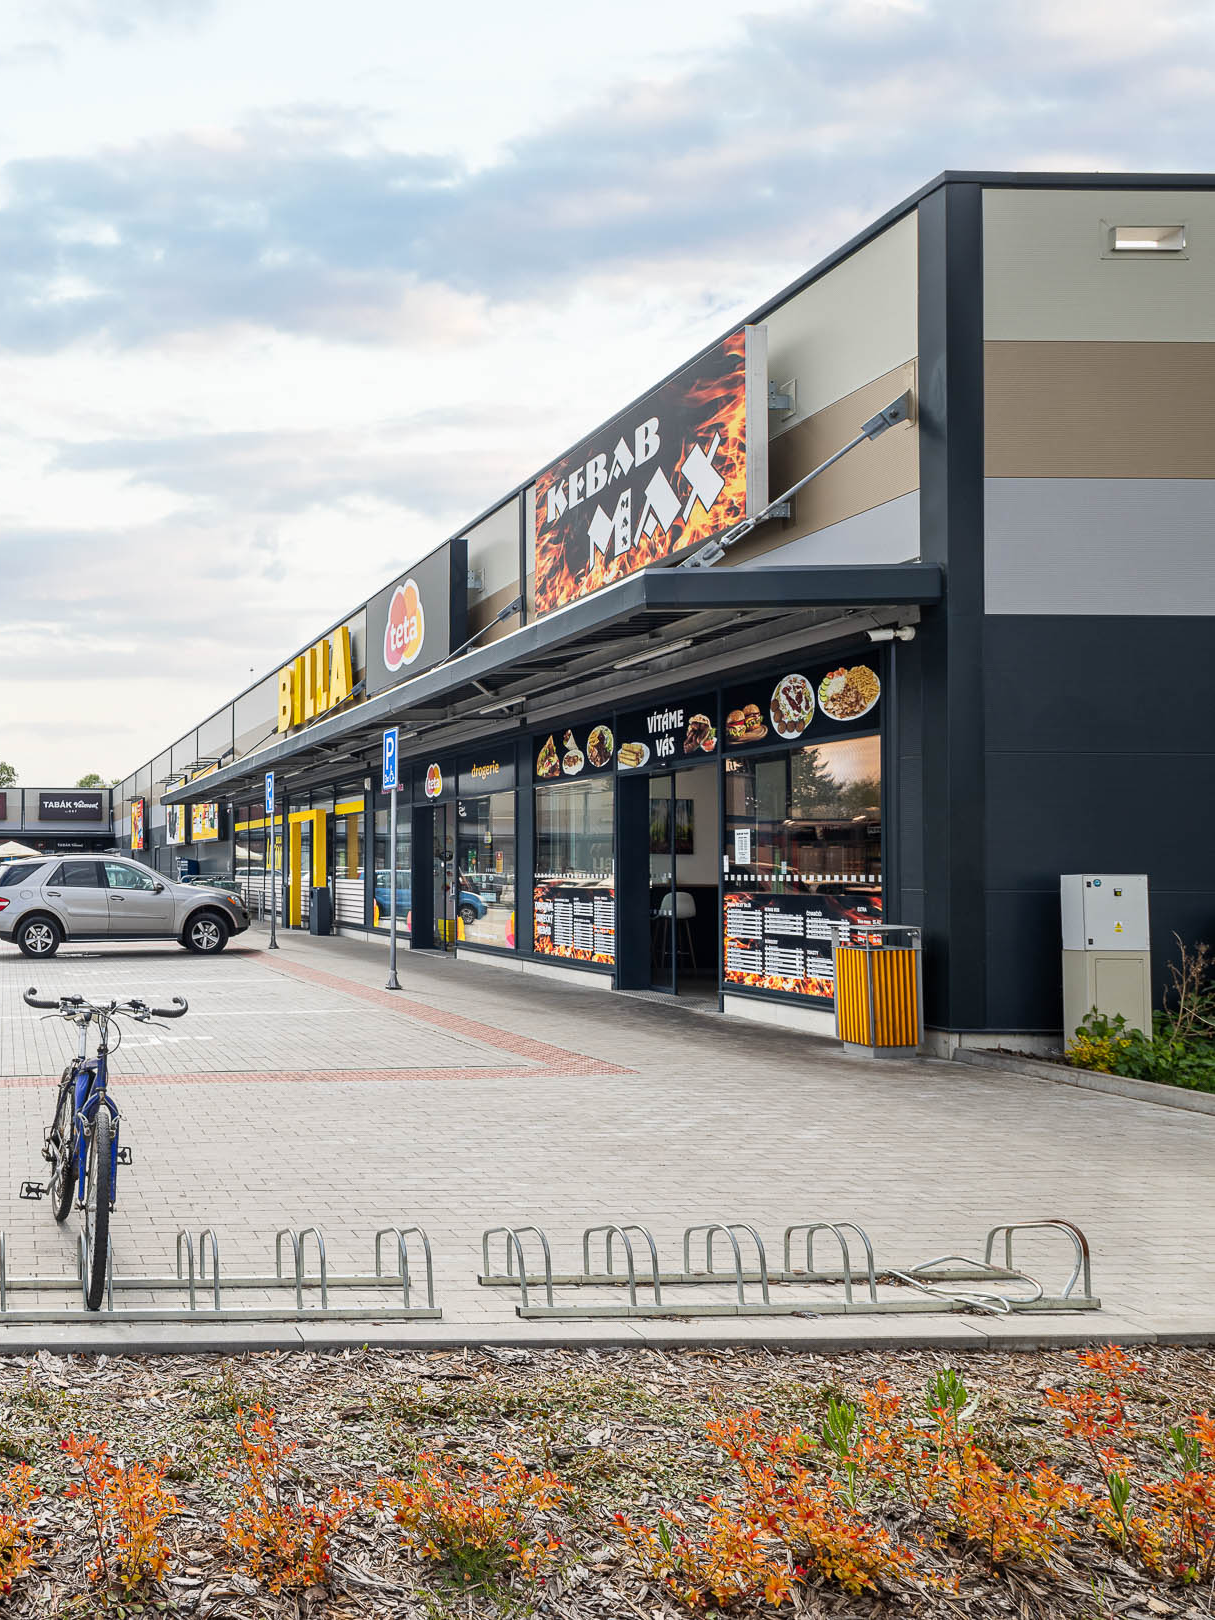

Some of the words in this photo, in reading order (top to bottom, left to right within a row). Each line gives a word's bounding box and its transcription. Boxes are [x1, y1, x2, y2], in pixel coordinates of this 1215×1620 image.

[547, 417, 661, 524] KEBAB
[587, 431, 726, 571] MAX
[390, 615, 418, 651] teta
[278, 625, 354, 734] BILLA
[647, 708, 684, 734] VÍTÁME
[386, 736, 394, 771] P
[655, 733, 675, 758] VÁS
[471, 760, 500, 780] drogerie
[43, 799, 72, 809] TABÁK
